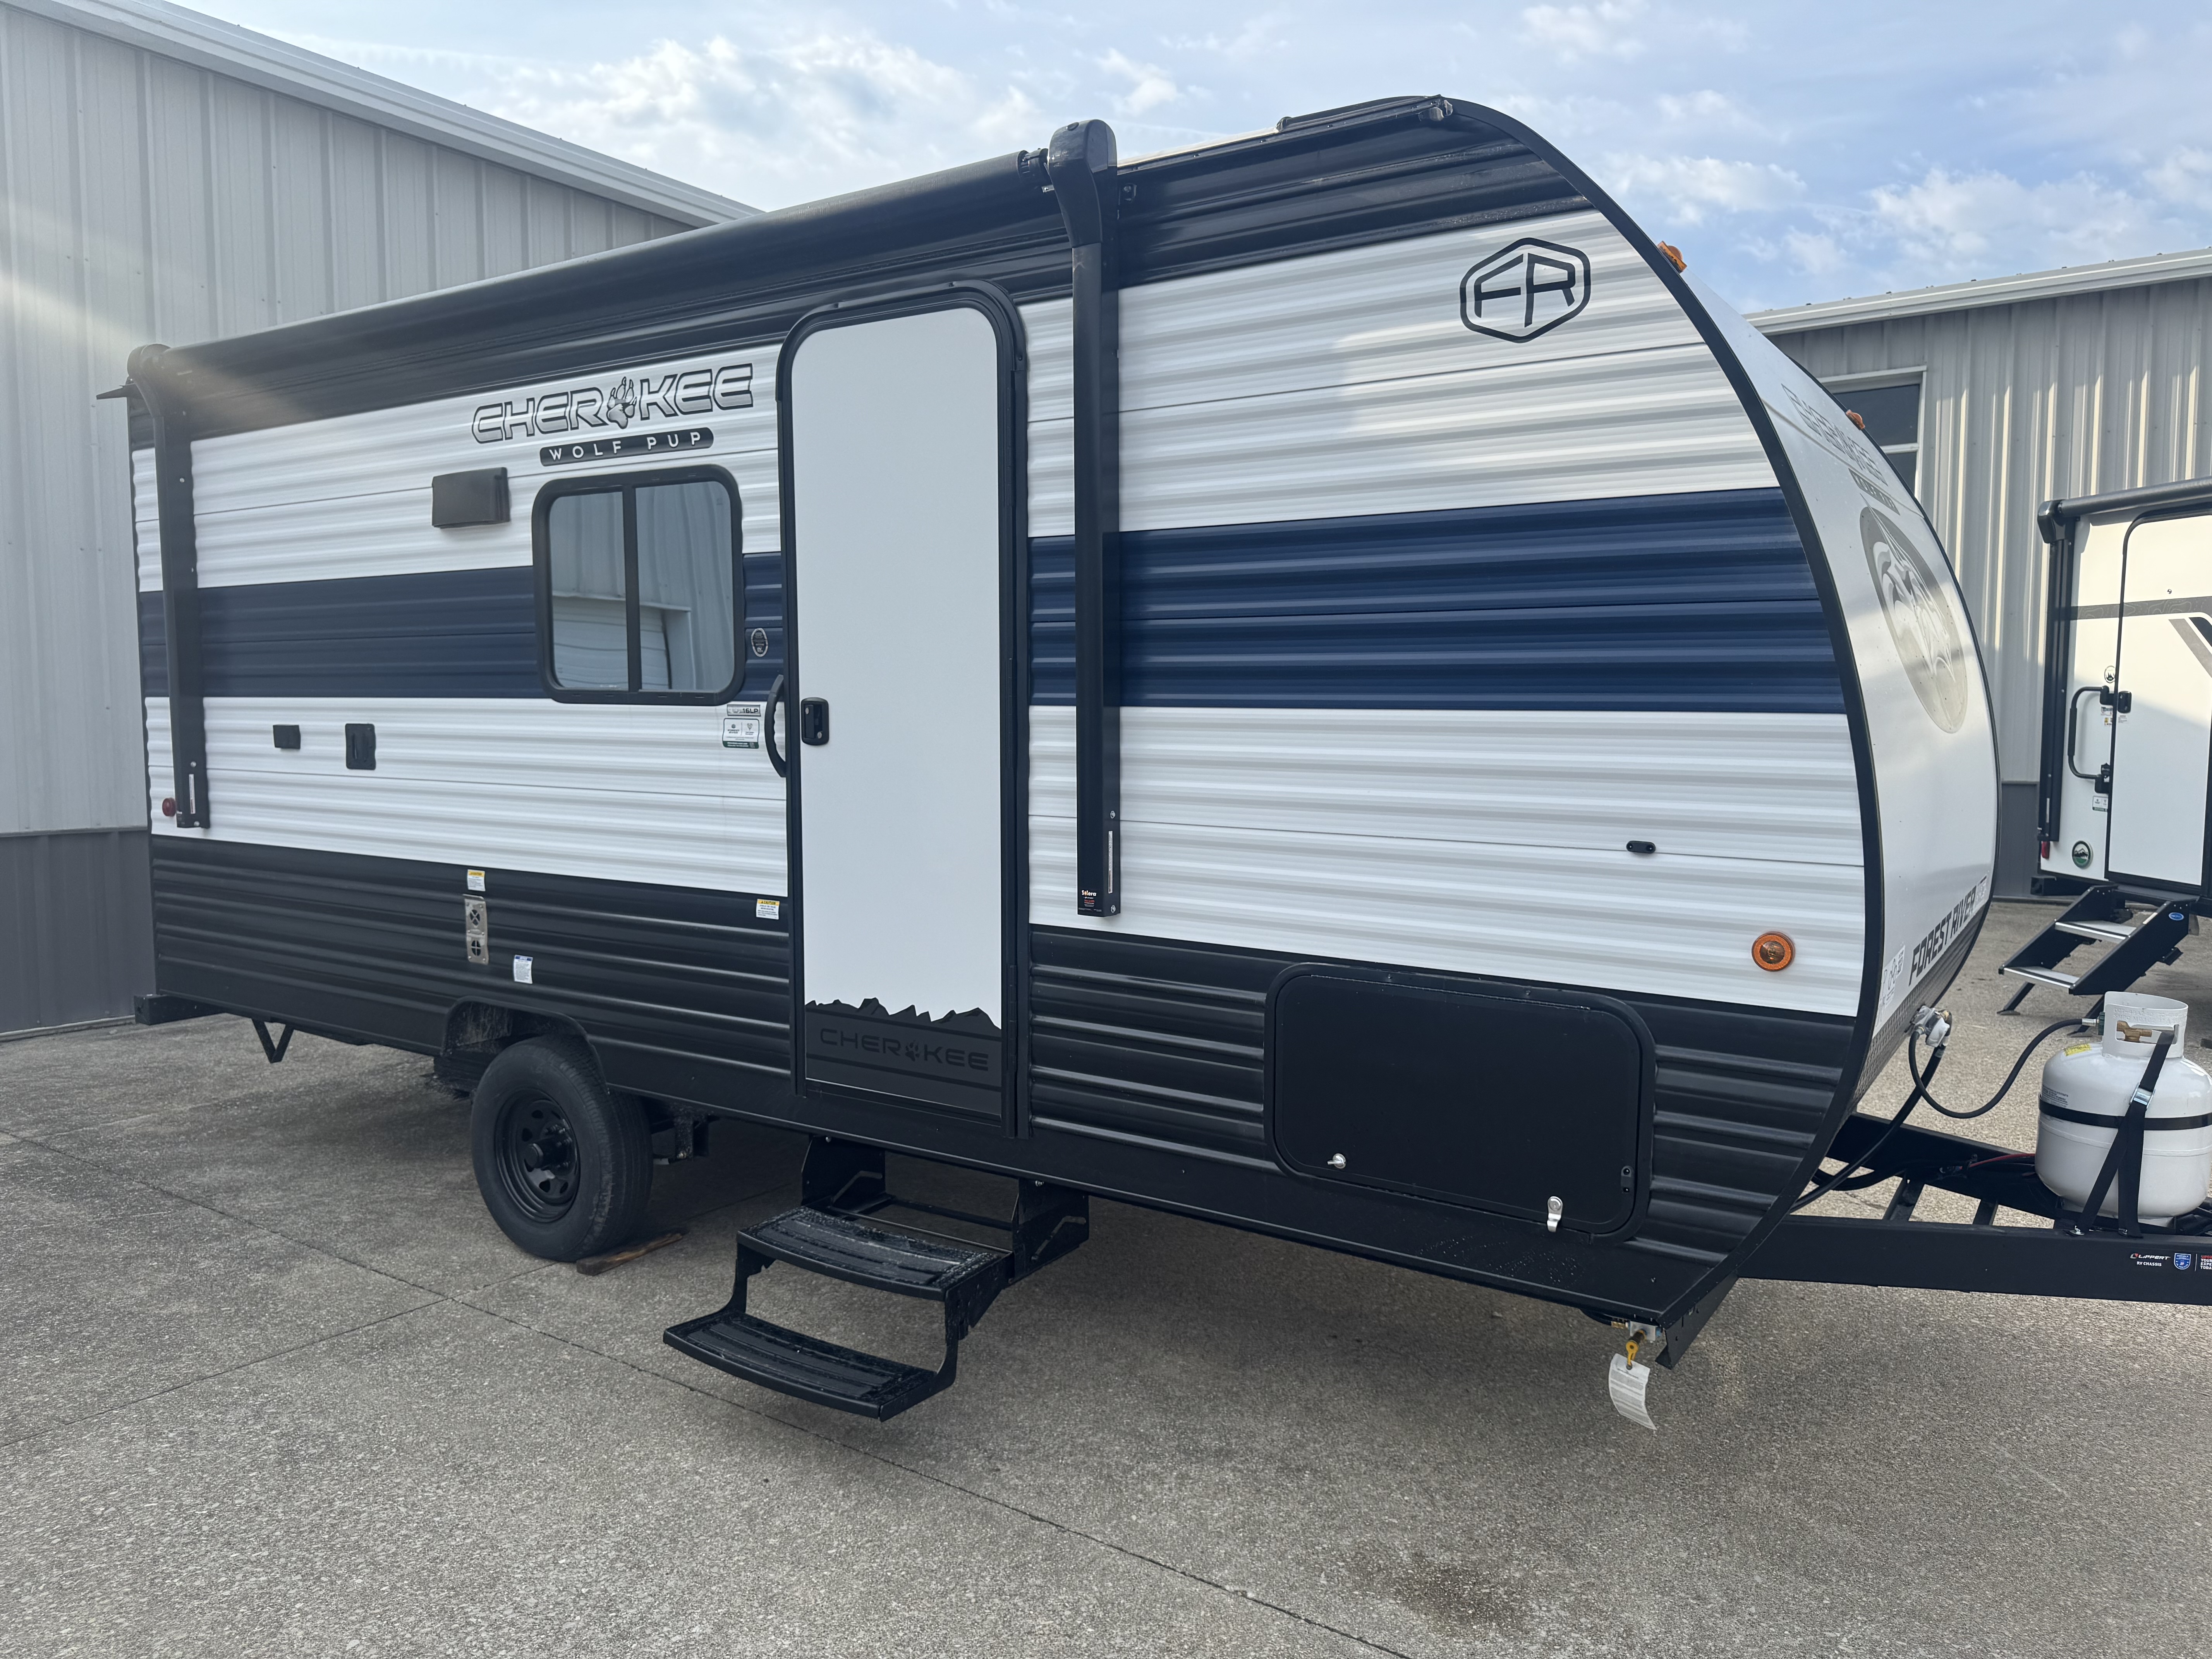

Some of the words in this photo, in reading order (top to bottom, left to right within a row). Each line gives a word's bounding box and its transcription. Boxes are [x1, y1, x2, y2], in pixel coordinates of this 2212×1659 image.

[549, 441, 622, 461] WOLF
[647, 432, 701, 450] PUP
[1908, 910, 1952, 987] FOREST
[1950, 885, 1977, 939] RIVER
